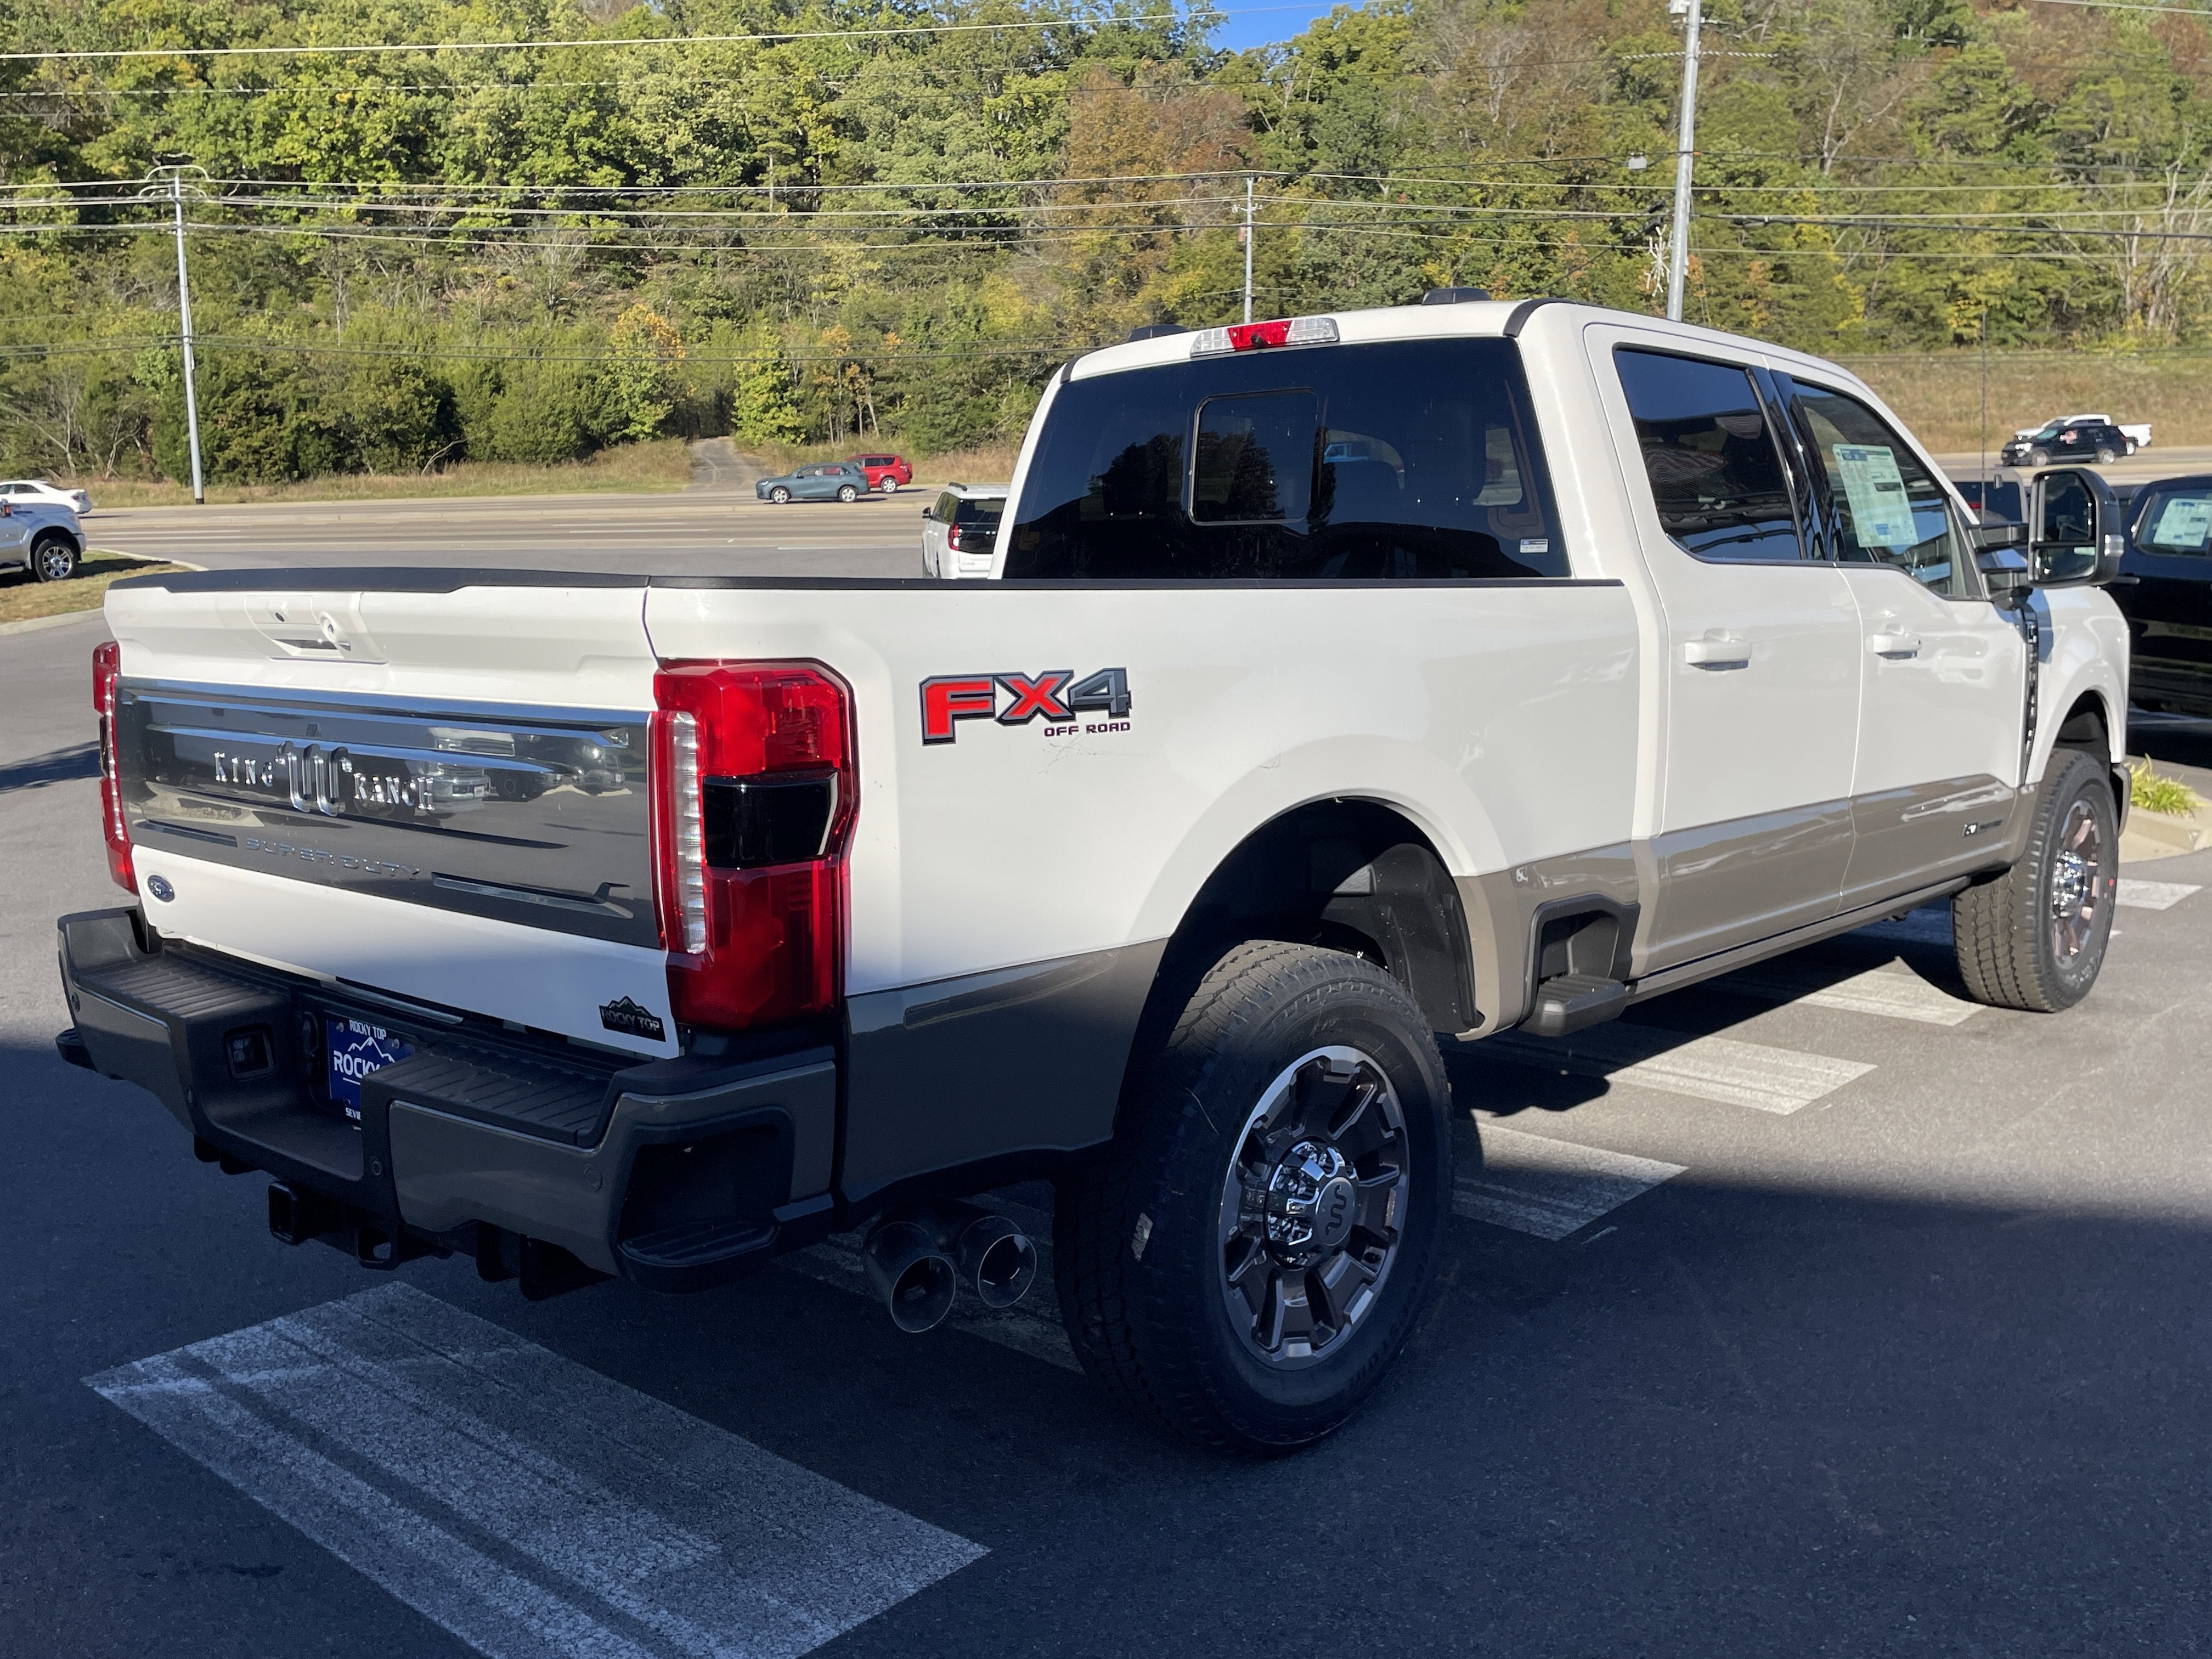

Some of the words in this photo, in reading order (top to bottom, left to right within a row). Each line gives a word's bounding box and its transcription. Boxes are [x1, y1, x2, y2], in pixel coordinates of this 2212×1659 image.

[919, 667, 1132, 746] FX4
[1044, 725, 1079, 737] OFF
[1086, 721, 1131, 734] ROAD
[213, 751, 273, 788] KING
[353, 772, 434, 811] RANCH
[245, 838, 334, 865] SUPER
[340, 854, 420, 881] DUTY
[349, 1019, 371, 1036] ROCKY
[373, 1026, 386, 1040] TOP
[601, 1009, 635, 1026] ROCKY
[637, 1016, 660, 1031] TOP
[334, 1050, 380, 1078] ROCKY
